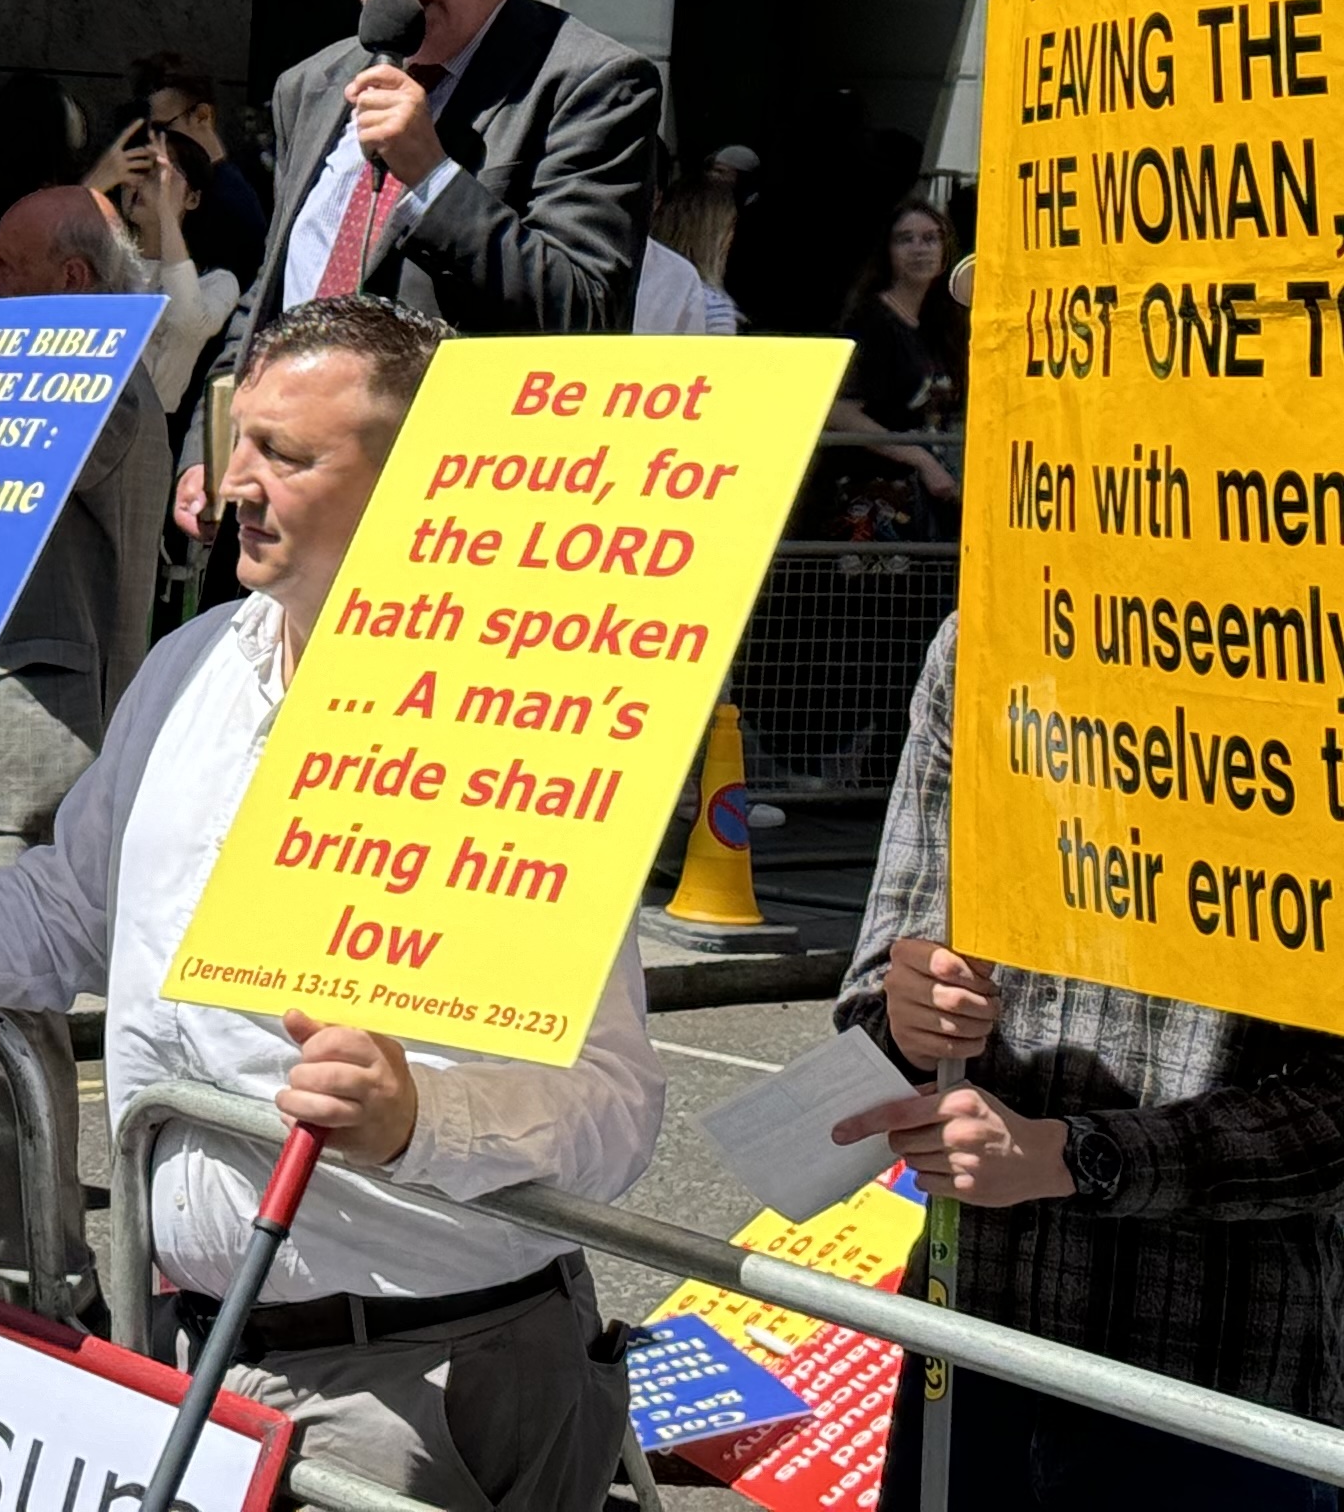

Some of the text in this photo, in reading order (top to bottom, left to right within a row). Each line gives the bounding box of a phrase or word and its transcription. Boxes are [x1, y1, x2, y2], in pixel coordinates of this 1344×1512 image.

[1021, 11, 1176, 127] LEAVING
[1017, 138, 1344, 260] THE WOMAN,
[28, 327, 128, 360] BIBLE
[1026, 279, 1344, 381] LUST ONE T
[21, 372, 115, 405] LORD
[510, 370, 712, 422] Be not
[425, 445, 740, 507] proud, for
[1009, 439, 1344, 547] Men with men
[408, 516, 695, 579] the LORD
[334, 587, 711, 666] hath spoken
[1043, 566, 1075, 661] is
[394, 670, 439, 720] A
[454, 684, 652, 742] man's
[288, 742, 624, 825] pride shall
[1007, 685, 1296, 818] themselves
[273, 816, 570, 904] bring him
[1058, 817, 1333, 953] their error
[325, 904, 446, 972] low
[179, 954, 570, 1044] (Jeremiah 13:15, Proverbs 29:23)
[627, 1335, 707, 1365] lust
[647, 1389, 745, 1423] gave
[654, 1408, 747, 1442] God
[741, 1344, 905, 1483] ornications
[774, 1375, 898, 1483] houghts
